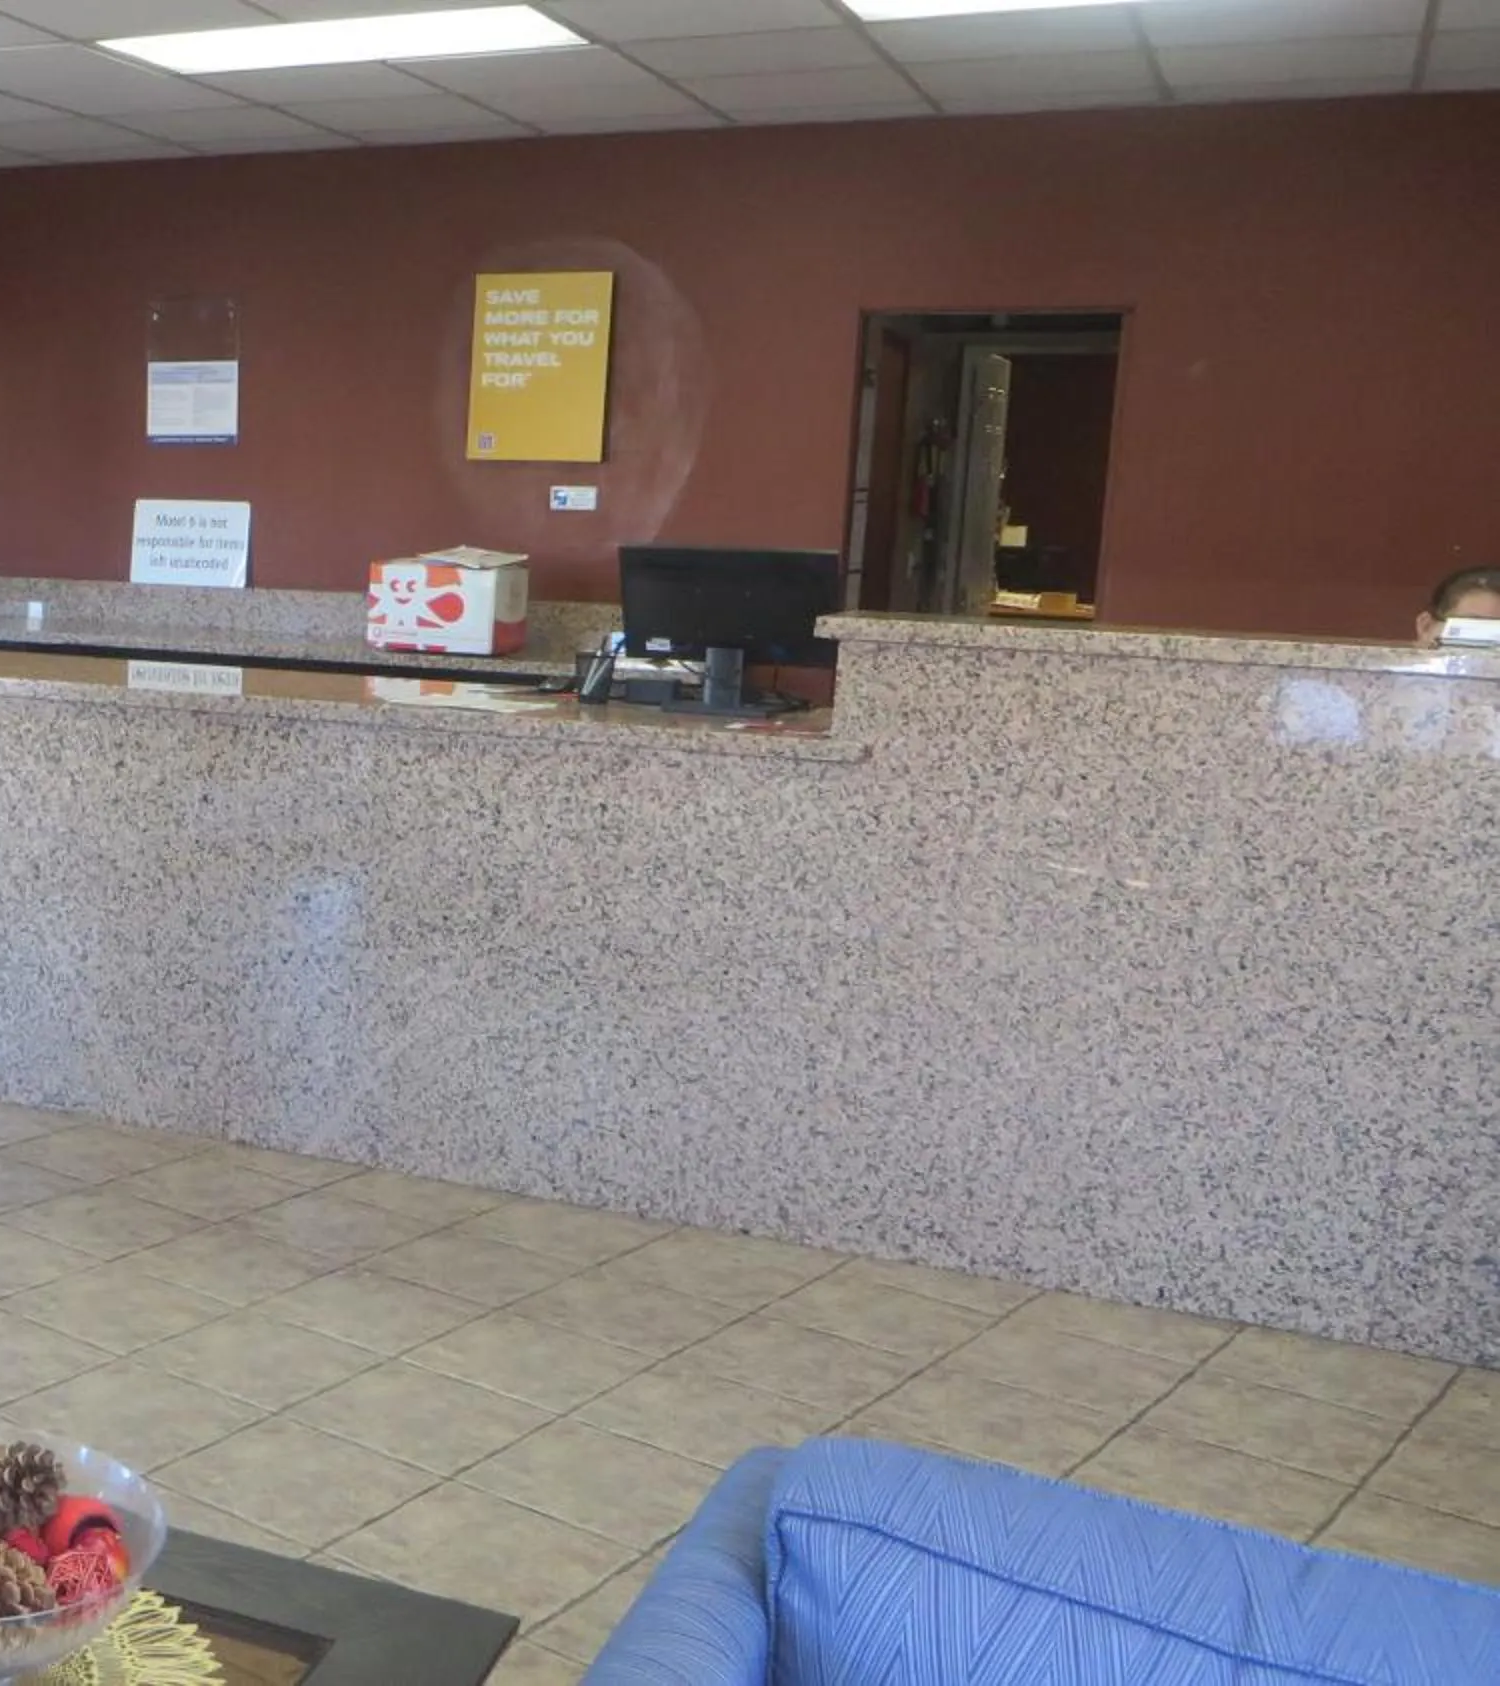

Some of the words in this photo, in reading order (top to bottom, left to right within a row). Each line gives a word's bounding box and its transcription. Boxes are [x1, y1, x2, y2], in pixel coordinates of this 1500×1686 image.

[486, 289, 541, 304] SAVE
[485, 311, 549, 325] MORE
[555, 309, 599, 326] FOR
[484, 331, 542, 347] WHAT
[550, 331, 594, 347] YOU
[484, 352, 561, 367] TRAVEL
